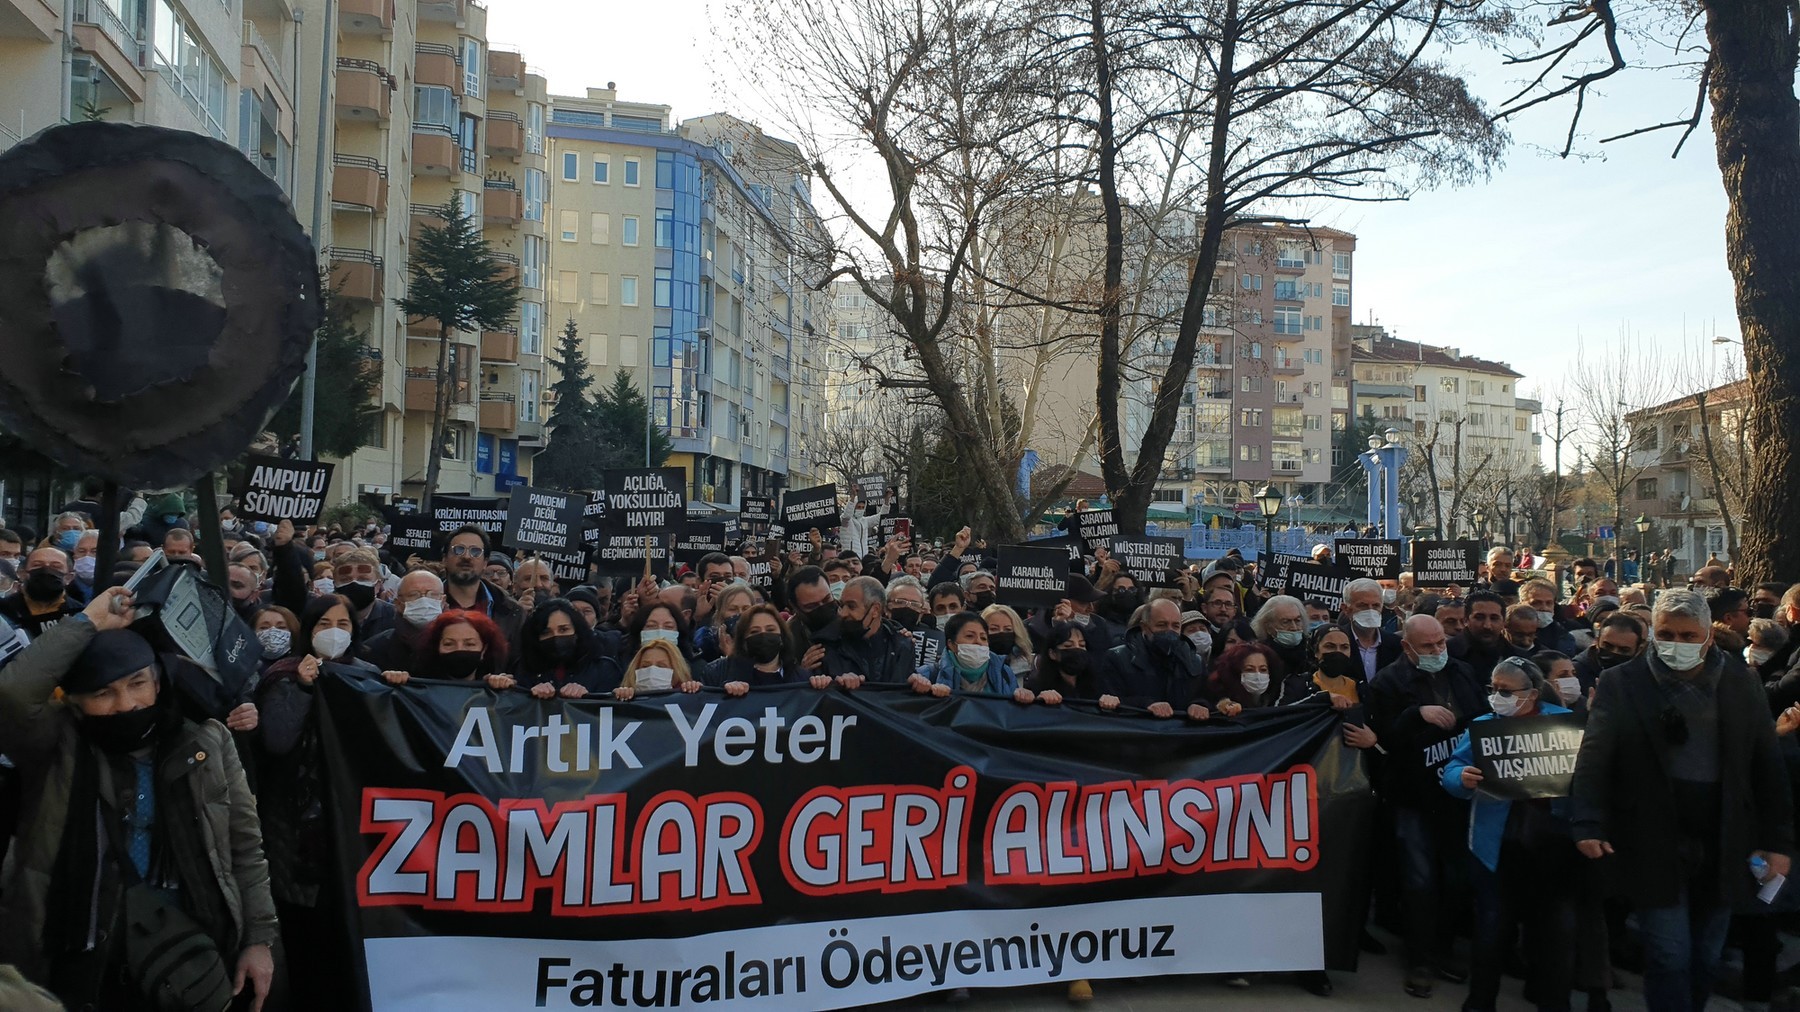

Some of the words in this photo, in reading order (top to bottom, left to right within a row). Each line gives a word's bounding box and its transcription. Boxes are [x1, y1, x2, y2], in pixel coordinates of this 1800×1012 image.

[249, 465, 326, 493] AMPULÜ
[623, 473, 667, 493] AÇLIĞA,
[244, 490, 321, 518] SÖNDÜR!
[529, 493, 567, 509] PANDEMİ
[609, 490, 682, 509] YOKSULLUĞA
[434, 507, 461, 519] KRİZİN
[462, 509, 508, 520] FATURASINI
[534, 507, 557, 520] DEĞİL
[786, 502, 805, 514] ENERJİ
[626, 511, 665, 526] HAYIR!
[1080, 511, 1113, 525] SARAYIN
[520, 517, 567, 535] FATURALAR
[1080, 524, 1119, 539] IŞIKLARINI
[406, 528, 432, 539] SEFALETİ
[517, 529, 567, 547] ÖLDÜRECEK!
[689, 535, 711, 543] SEFALETİ
[393, 537, 410, 547] KABUL
[609, 536, 633, 547] ARTIK
[677, 542, 694, 550] KABUL
[1115, 541, 1152, 556] MÜŞTERİ
[1154, 543, 1180, 557] DEĞİL,
[1338, 543, 1371, 556] MÜŞTERİ
[1373, 544, 1397, 556] DEĞİL,
[1427, 548, 1456, 559] SOĞUĞA
[1457, 549, 1466, 558] VE
[1125, 556, 1170, 571] YURTTAŞIZ
[1347, 556, 1388, 567] YURTTAŞIZ
[1427, 558, 1467, 570] KARANLIĞA
[554, 564, 586, 580] ALIN!
[1011, 566, 1054, 578] KARANLIĞA
[1155, 571, 1166, 583] YA
[1374, 567, 1384, 576] YA
[1417, 571, 1451, 580] MAHKUM
[1452, 569, 1475, 580] DEĞİLİZ
[999, 578, 1034, 590] MAHKUM
[1034, 579, 1066, 591] DEĞİLİZ!
[444, 705, 644, 773] Artık
[665, 702, 858, 767] Yeter
[1423, 740, 1450, 767] ZAM
[1480, 736, 1504, 757] BU
[364, 793, 758, 909] ZAMLAR
[785, 772, 969, 887] GERİ
[991, 771, 1312, 875] ALINSIN!
[535, 950, 807, 1008] Faturaları
[820, 921, 1176, 990] Ödeyemiyoruz
